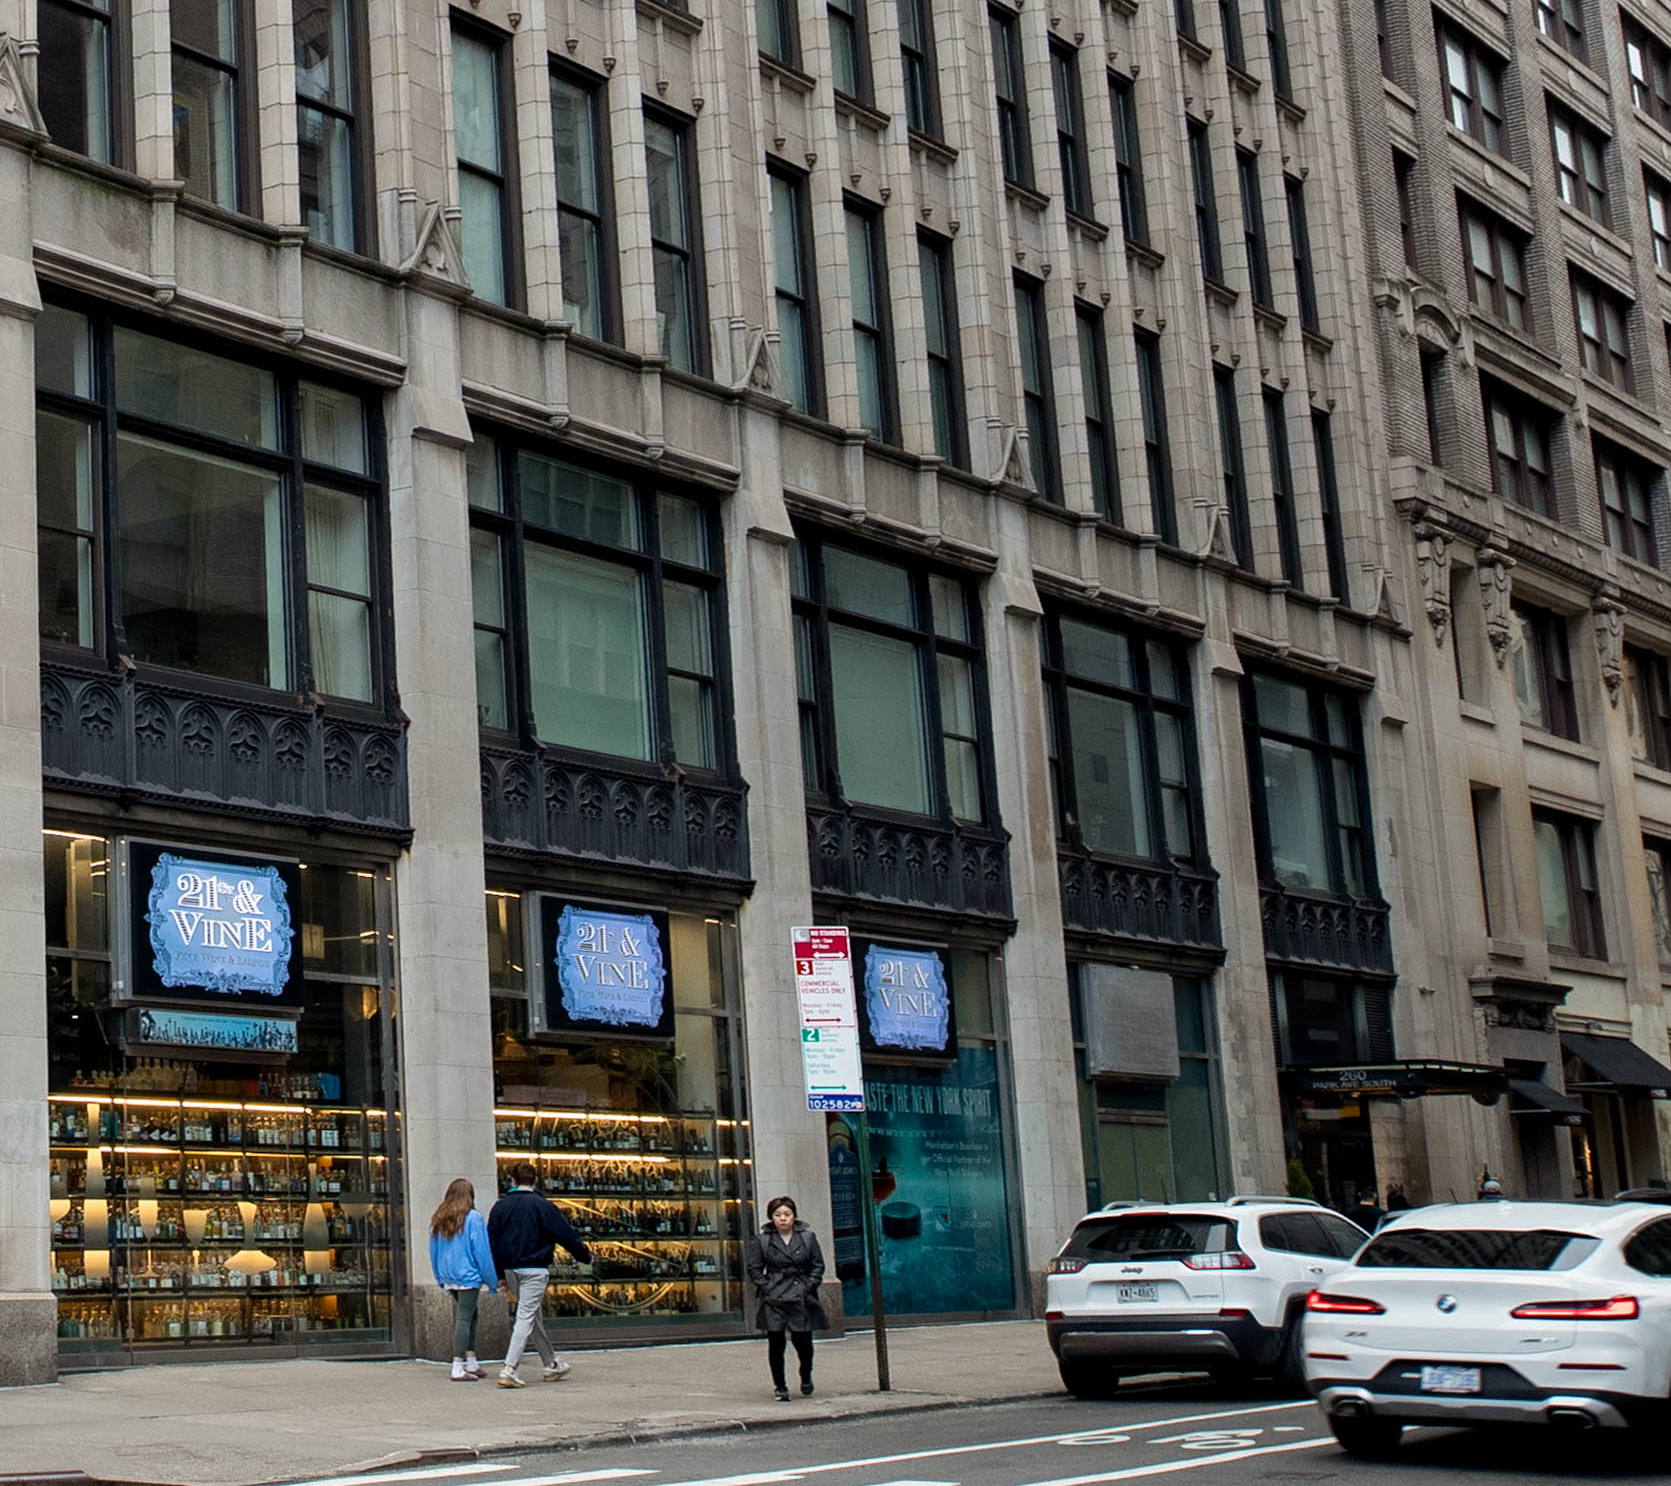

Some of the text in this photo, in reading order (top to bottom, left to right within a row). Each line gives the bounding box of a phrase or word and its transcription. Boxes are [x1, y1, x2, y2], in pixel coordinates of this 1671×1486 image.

[233, 880, 264, 915] &
[169, 909, 273, 953] VINE
[619, 927, 641, 957] &
[572, 954, 649, 990] VINE
[800, 961, 810, 975] 3
[913, 963, 930, 989] &
[877, 987, 937, 1018] VINE
[806, 1028, 817, 1042] 2
[1339, 1070, 1367, 1082] 260
[809, 1100, 851, 1110] 102582
[865, 1082, 992, 1117] ASTE THE NEW YORK SPIRIT
[1120, 1266, 1144, 1275] Jeep
